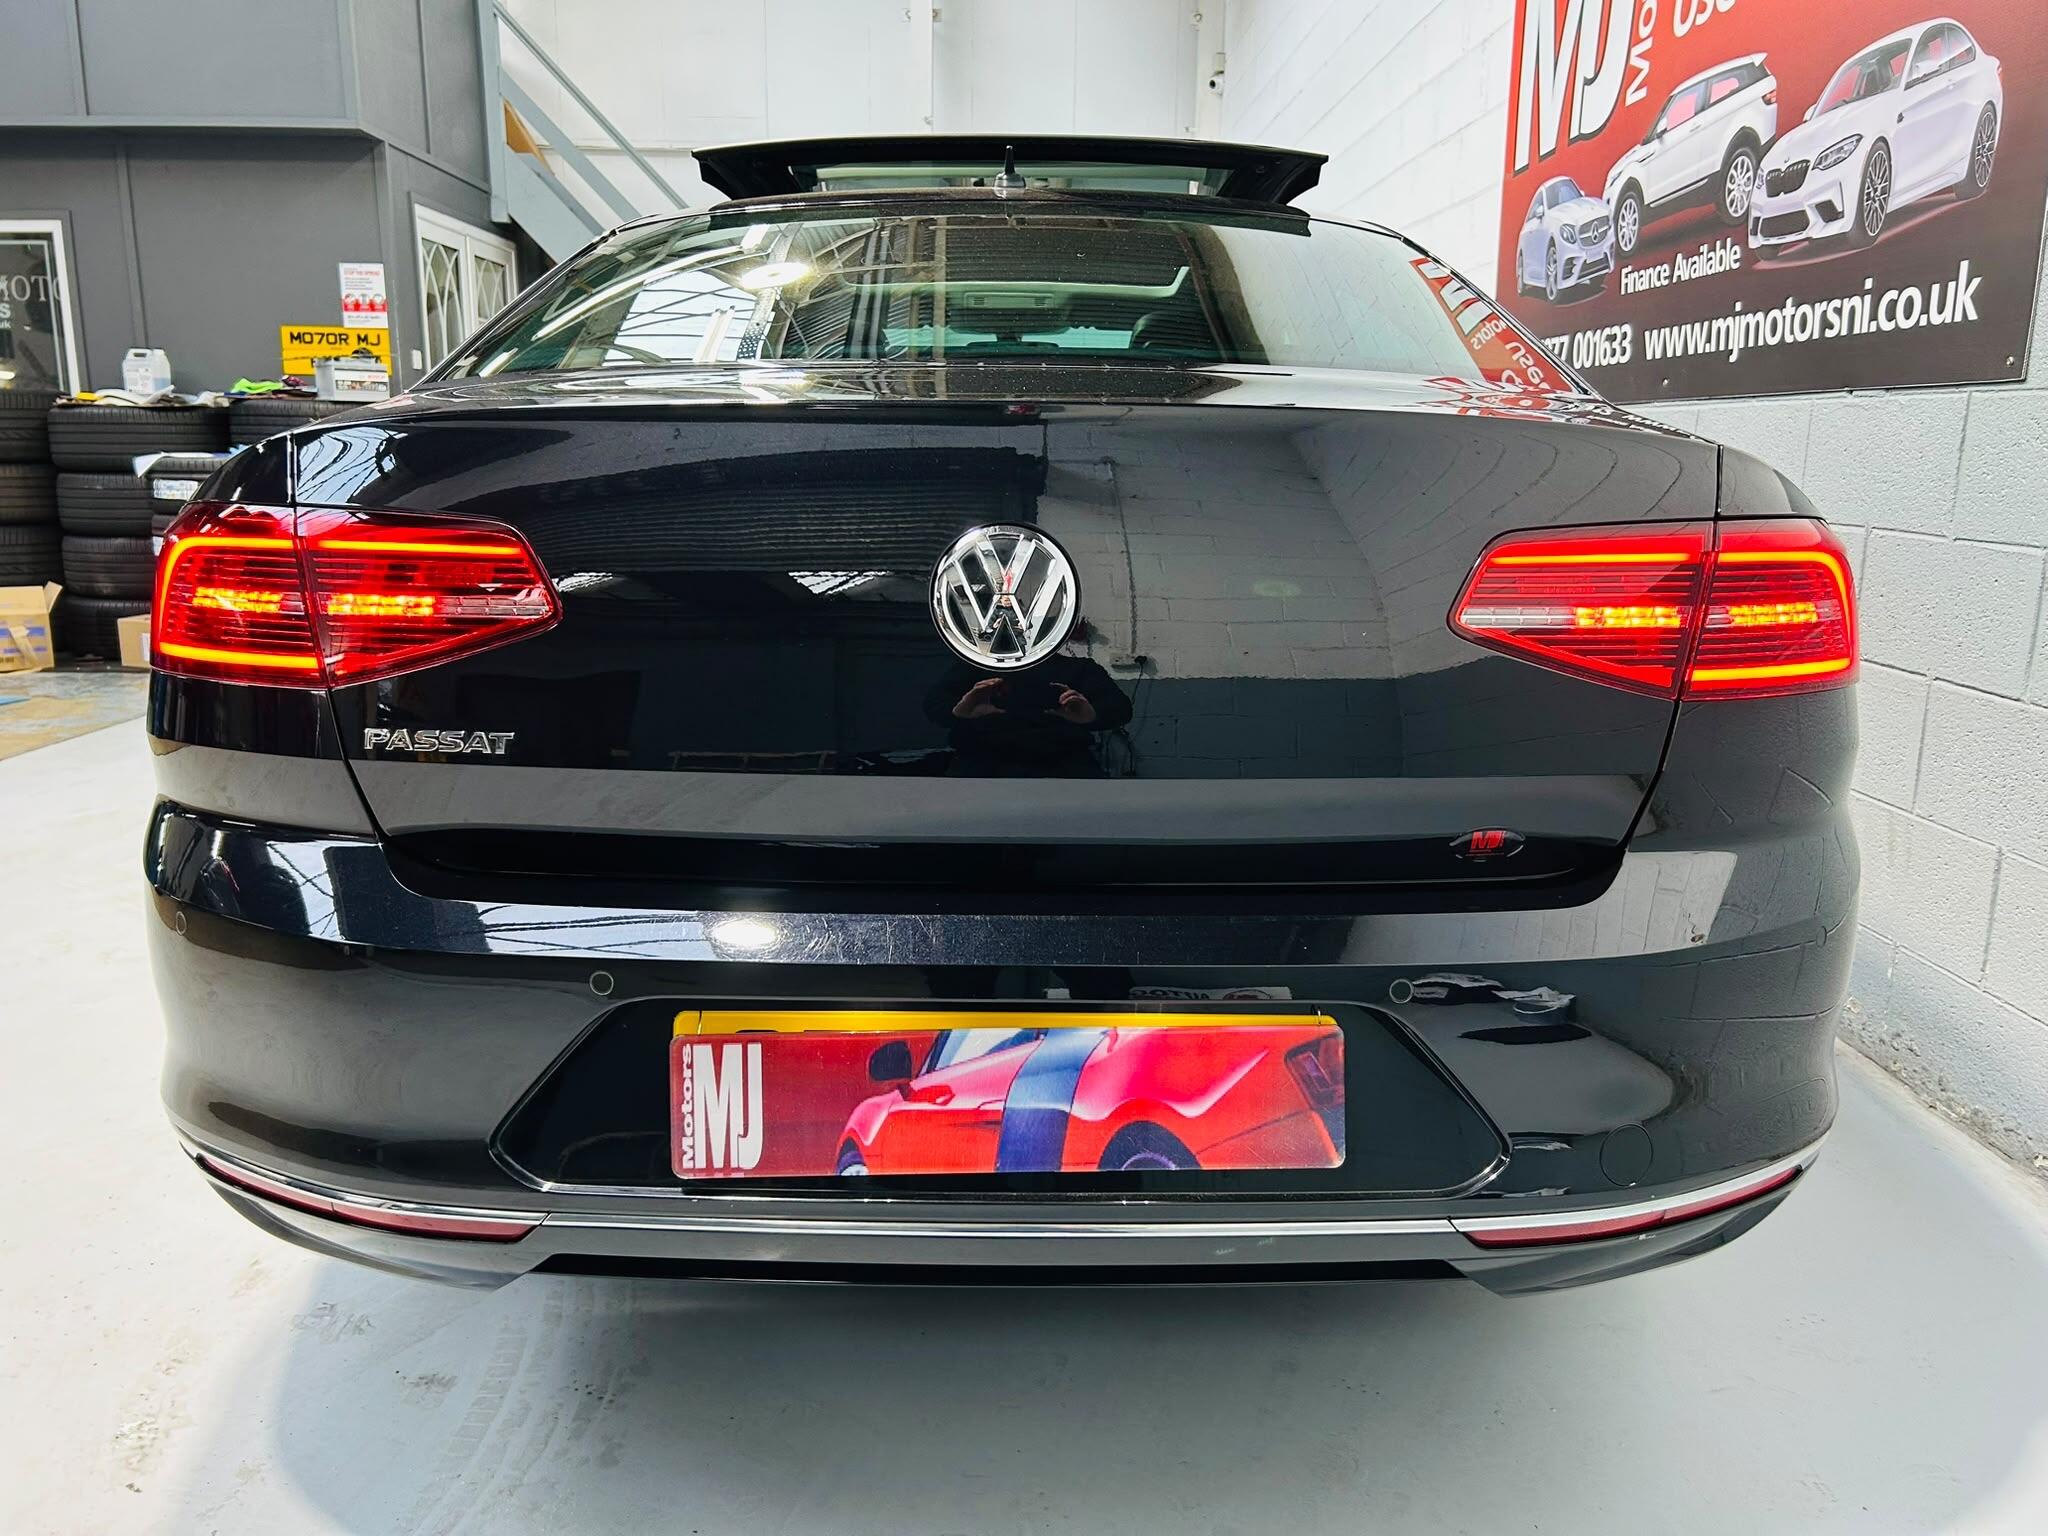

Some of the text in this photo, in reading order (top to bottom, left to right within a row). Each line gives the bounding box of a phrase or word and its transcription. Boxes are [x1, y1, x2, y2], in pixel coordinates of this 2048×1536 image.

[1620, 239, 1741, 295] Finance Available
[356, 333, 381, 346] MJ
[1573, 323, 1632, 370] 001633
[1644, 259, 1982, 363] www.mjmotorsni.co.uk
[364, 727, 515, 755] PASSAT
[681, 1042, 694, 1169] Motors
[692, 1041, 764, 1170] MJ
